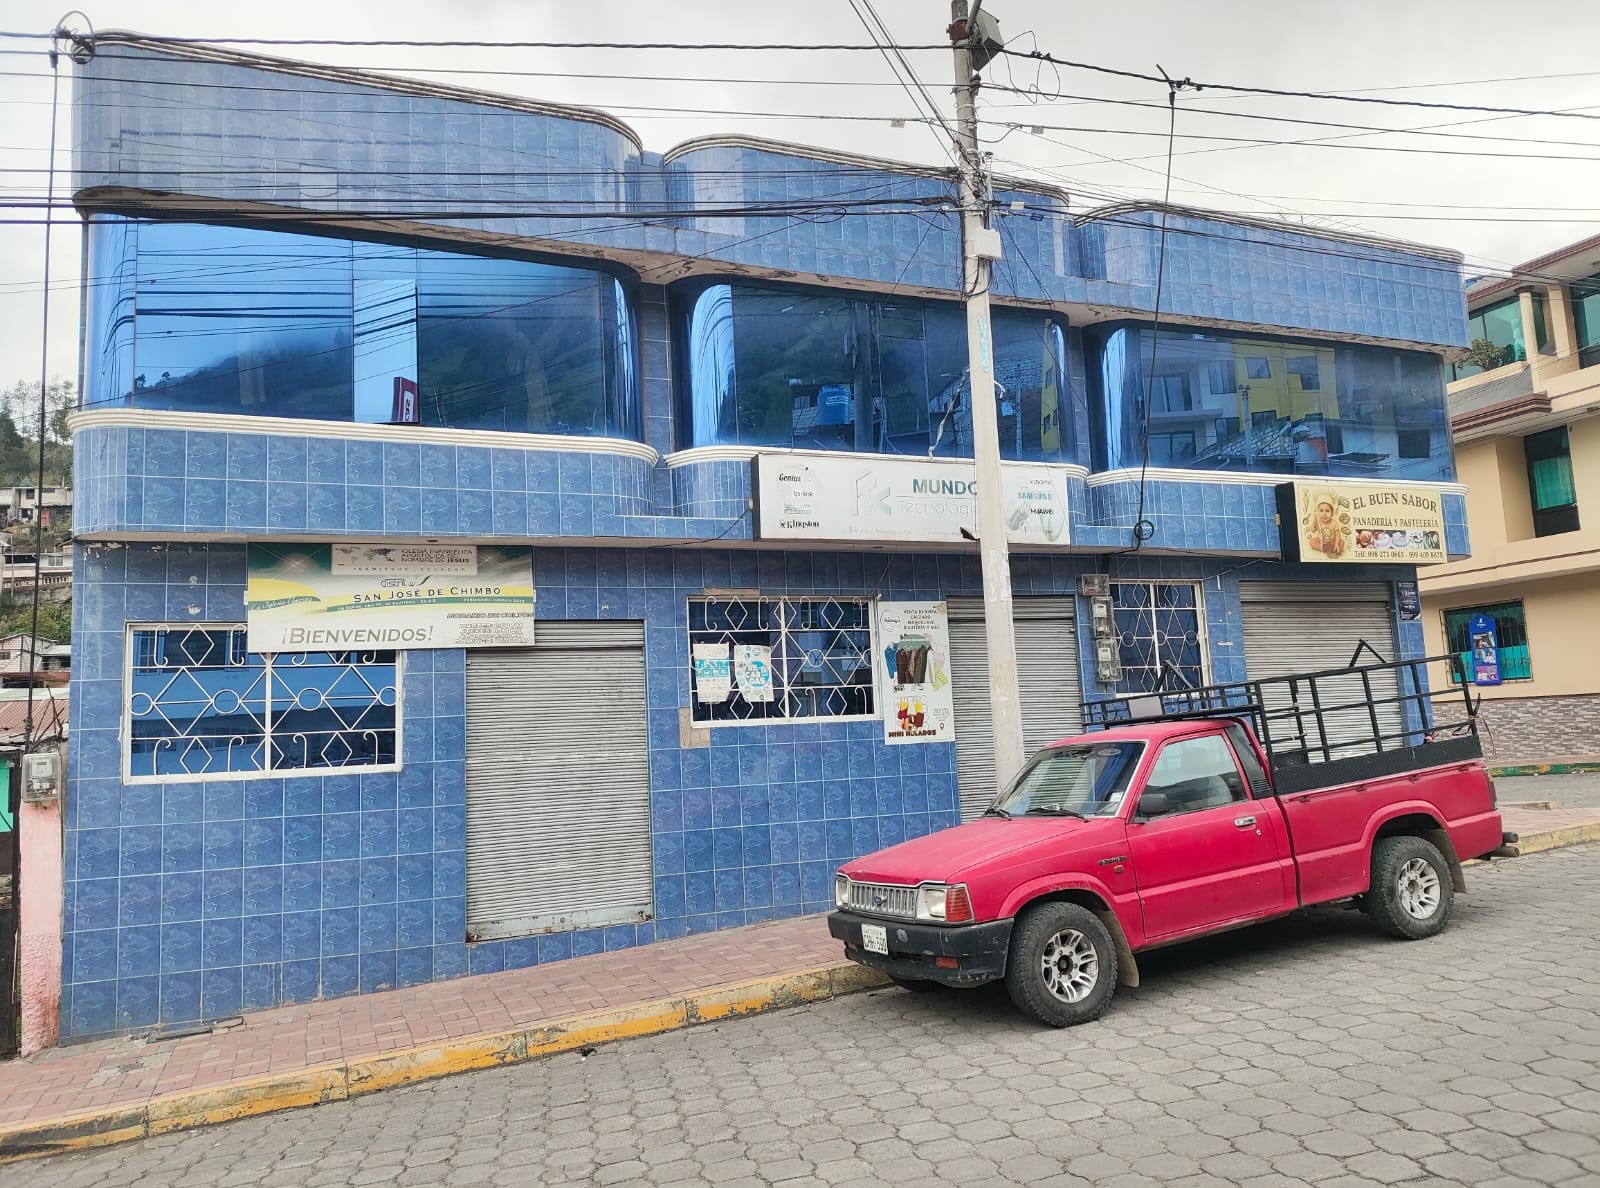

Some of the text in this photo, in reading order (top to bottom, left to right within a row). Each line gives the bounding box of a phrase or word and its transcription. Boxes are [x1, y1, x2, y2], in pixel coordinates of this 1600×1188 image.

[778, 473, 802, 482] Genius
[897, 499, 974, 518] Tecnológi
[1352, 492, 1438, 513] EL BUEN SABOR
[1353, 514, 1440, 529] PANADERÍA Y PASTELERÍA
[353, 593, 381, 603] SAN
[388, 587, 421, 600] JOSÉ
[428, 588, 445, 597] DE
